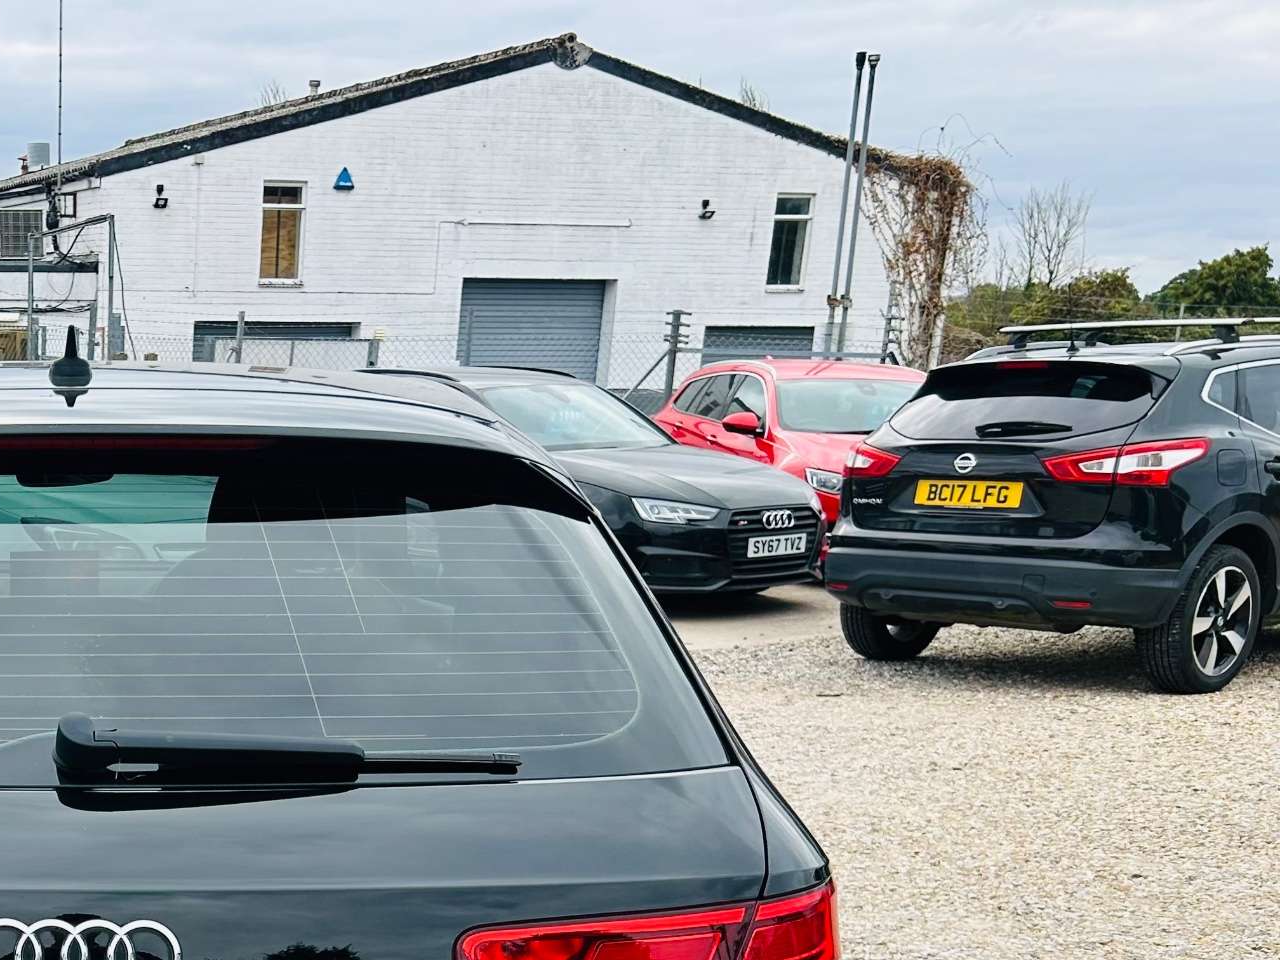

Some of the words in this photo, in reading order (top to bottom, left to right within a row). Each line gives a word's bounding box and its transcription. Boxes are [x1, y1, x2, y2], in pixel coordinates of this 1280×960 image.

[926, 484, 967, 502] BC17
[970, 485, 1010, 503] LFG
[753, 538, 781, 554] SY67
[783, 537, 803, 552] TVZ
